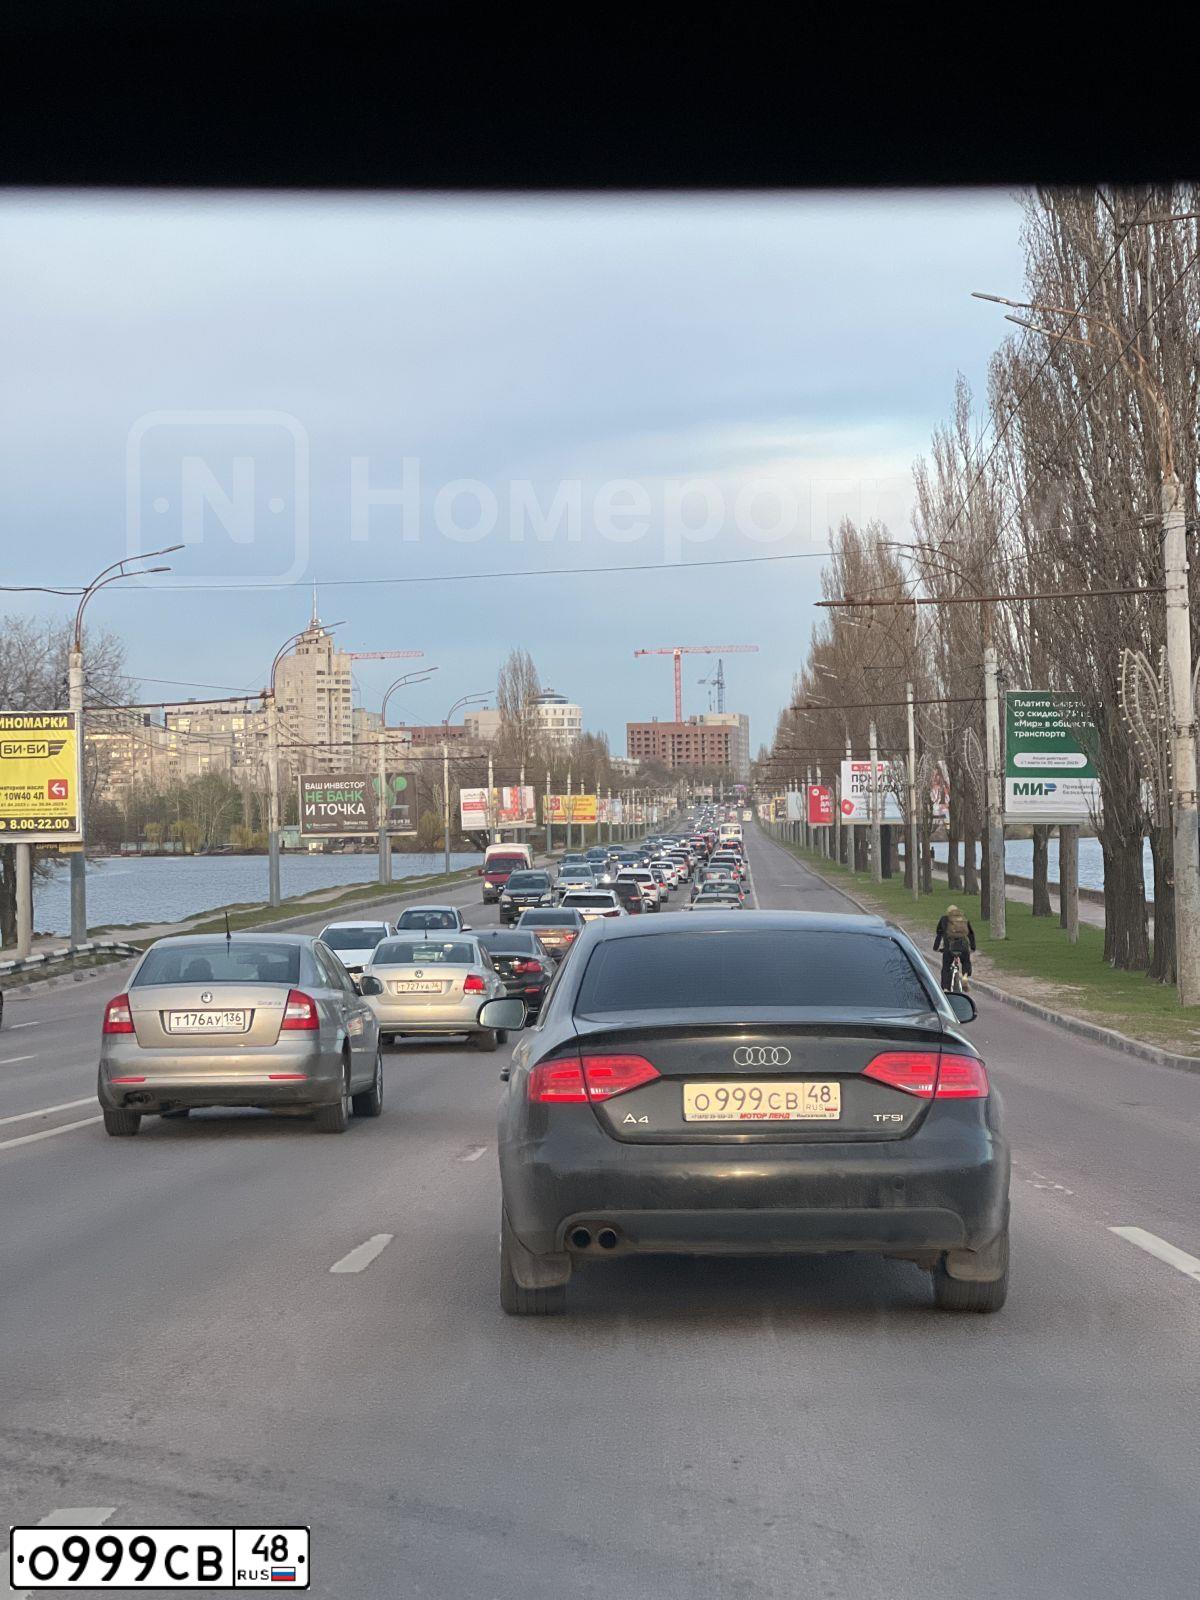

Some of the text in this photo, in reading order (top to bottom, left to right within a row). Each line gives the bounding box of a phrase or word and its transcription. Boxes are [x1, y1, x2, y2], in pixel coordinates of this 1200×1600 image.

[1014, 720, 1043, 728] «Мир»
[324, 781, 366, 789] ИНВЕСТОР
[1013, 783, 1057, 795] МИР
[4, 792, 44, 800] 10W40 4Л
[305, 790, 364, 802] НЕ БАНК
[305, 803, 366, 815] И ТОЧКА
[10, 818, 69, 830] 8.00-22.00
[175, 1012, 241, 1026] Т176АУ 136
[695, 1085, 831, 1111] О999СВ 48
[623, 1113, 649, 1124] A4
[873, 1114, 903, 1122] TFSI
